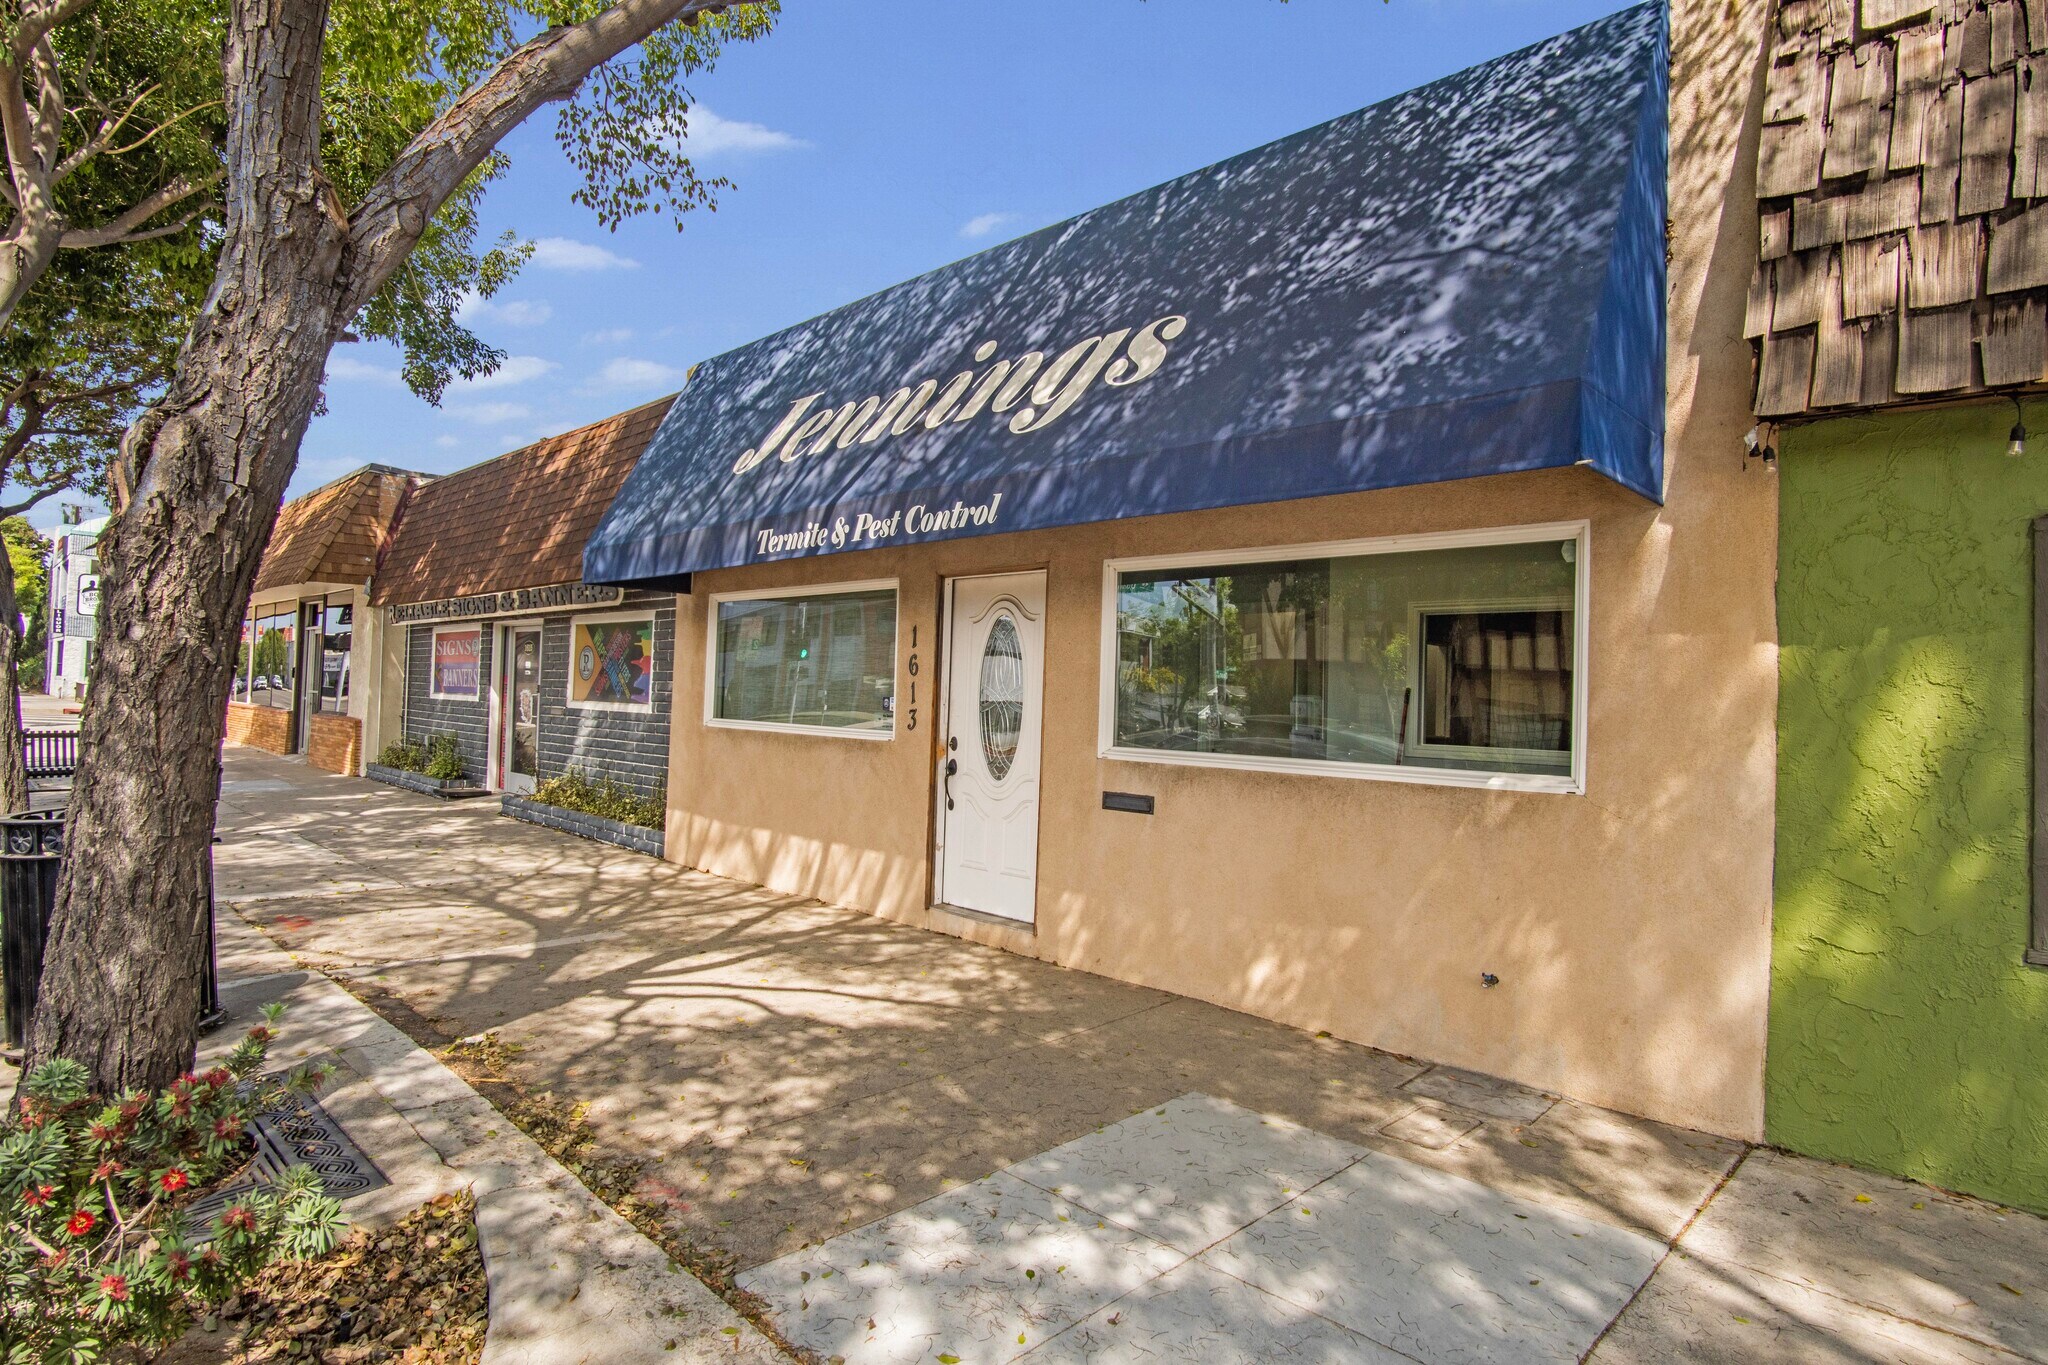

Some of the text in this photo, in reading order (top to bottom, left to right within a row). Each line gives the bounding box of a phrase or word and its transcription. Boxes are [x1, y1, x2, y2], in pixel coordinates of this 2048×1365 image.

[733, 315, 1188, 475] Jennings
[757, 493, 1003, 555] Termite & Pest Control
[388, 583, 619, 624] RELIABLE SIGNS & BANNERS
[436, 639, 472, 656] SIGNS
[443, 668, 478, 688] BANNERS
[907, 624, 919, 731] 1613
